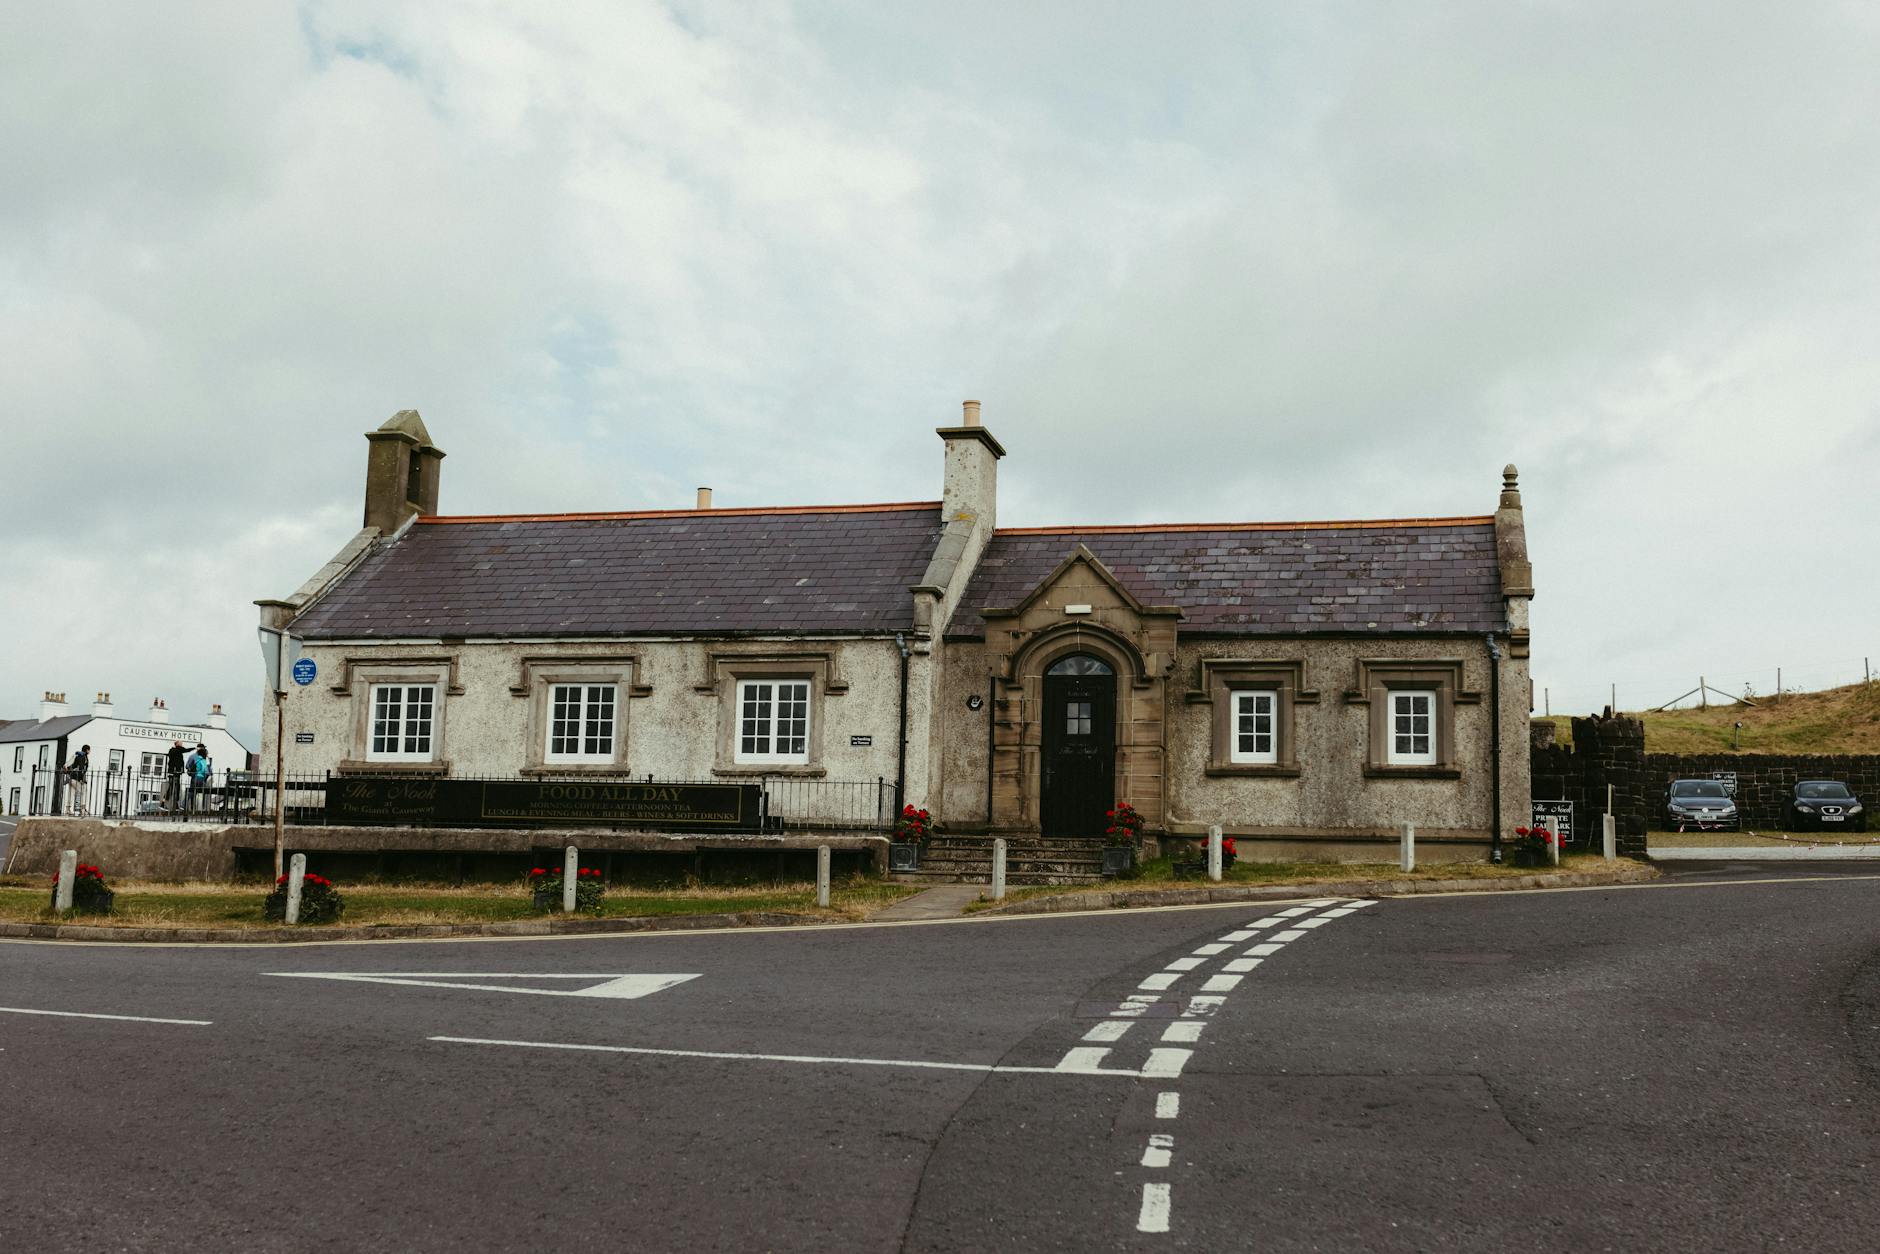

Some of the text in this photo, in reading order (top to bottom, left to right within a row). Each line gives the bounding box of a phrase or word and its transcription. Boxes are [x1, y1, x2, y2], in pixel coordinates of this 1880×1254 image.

[124, 727, 197, 741] CAUSEWAY HOTEL
[342, 781, 436, 799] The Nook
[539, 785, 684, 802] FOOD ALL DAY
[530, 801, 569, 809] MORNING
[615, 803, 671, 811] AFTERNOON
[1532, 804, 1572, 813] The Nook
[487, 808, 519, 816] LUNCH
[700, 812, 735, 820] DRINKS
